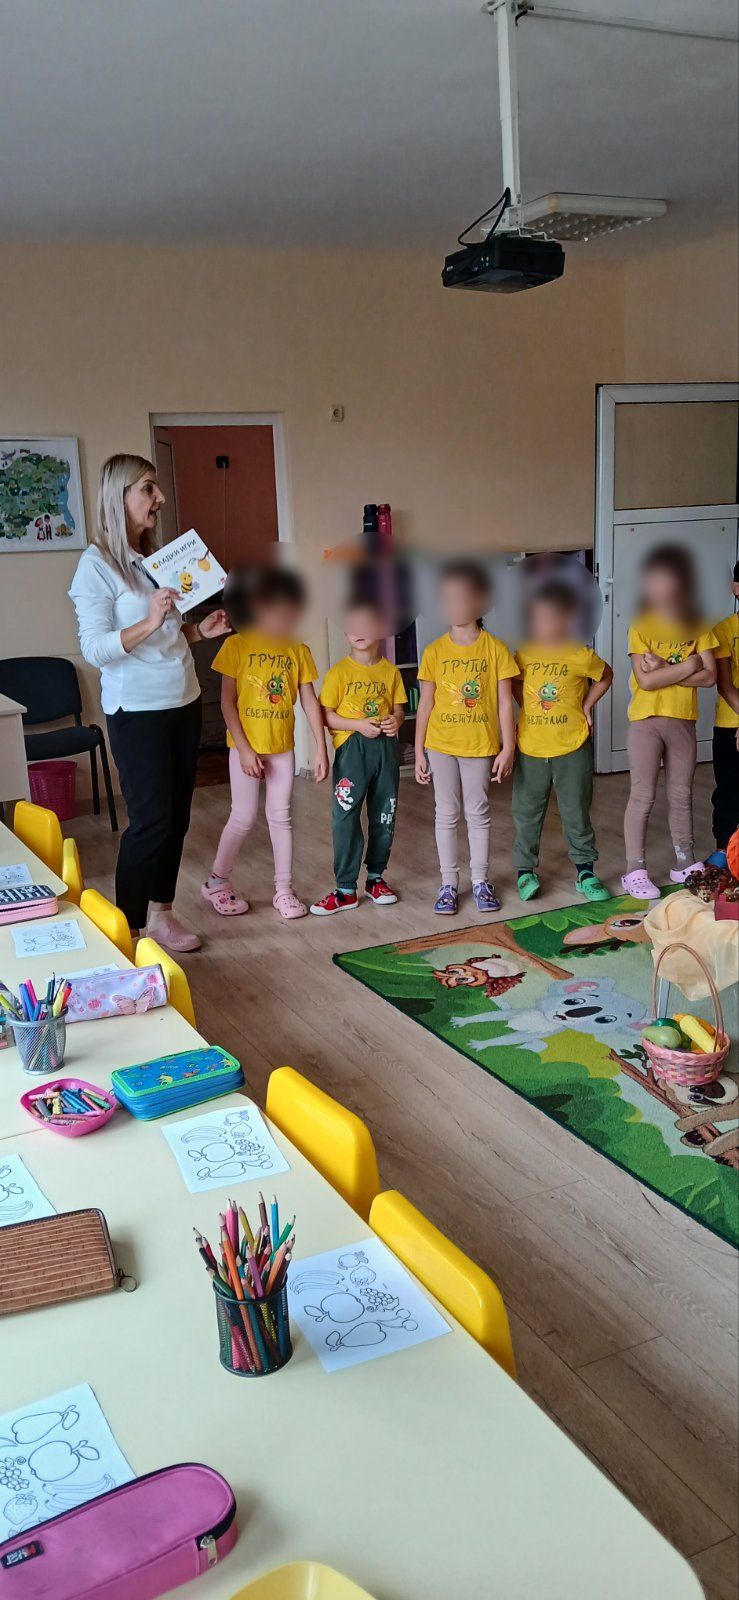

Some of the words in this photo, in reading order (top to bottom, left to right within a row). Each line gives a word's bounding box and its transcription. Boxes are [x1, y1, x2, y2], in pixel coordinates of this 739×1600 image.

[152, 549, 180, 570] СЛАДКИ
[180, 539, 197, 554] ИГРИ
[247, 653, 293, 670] ГРУПА
[441, 658, 489, 676] ГРУПА
[345, 681, 388, 696] ГРУПА
